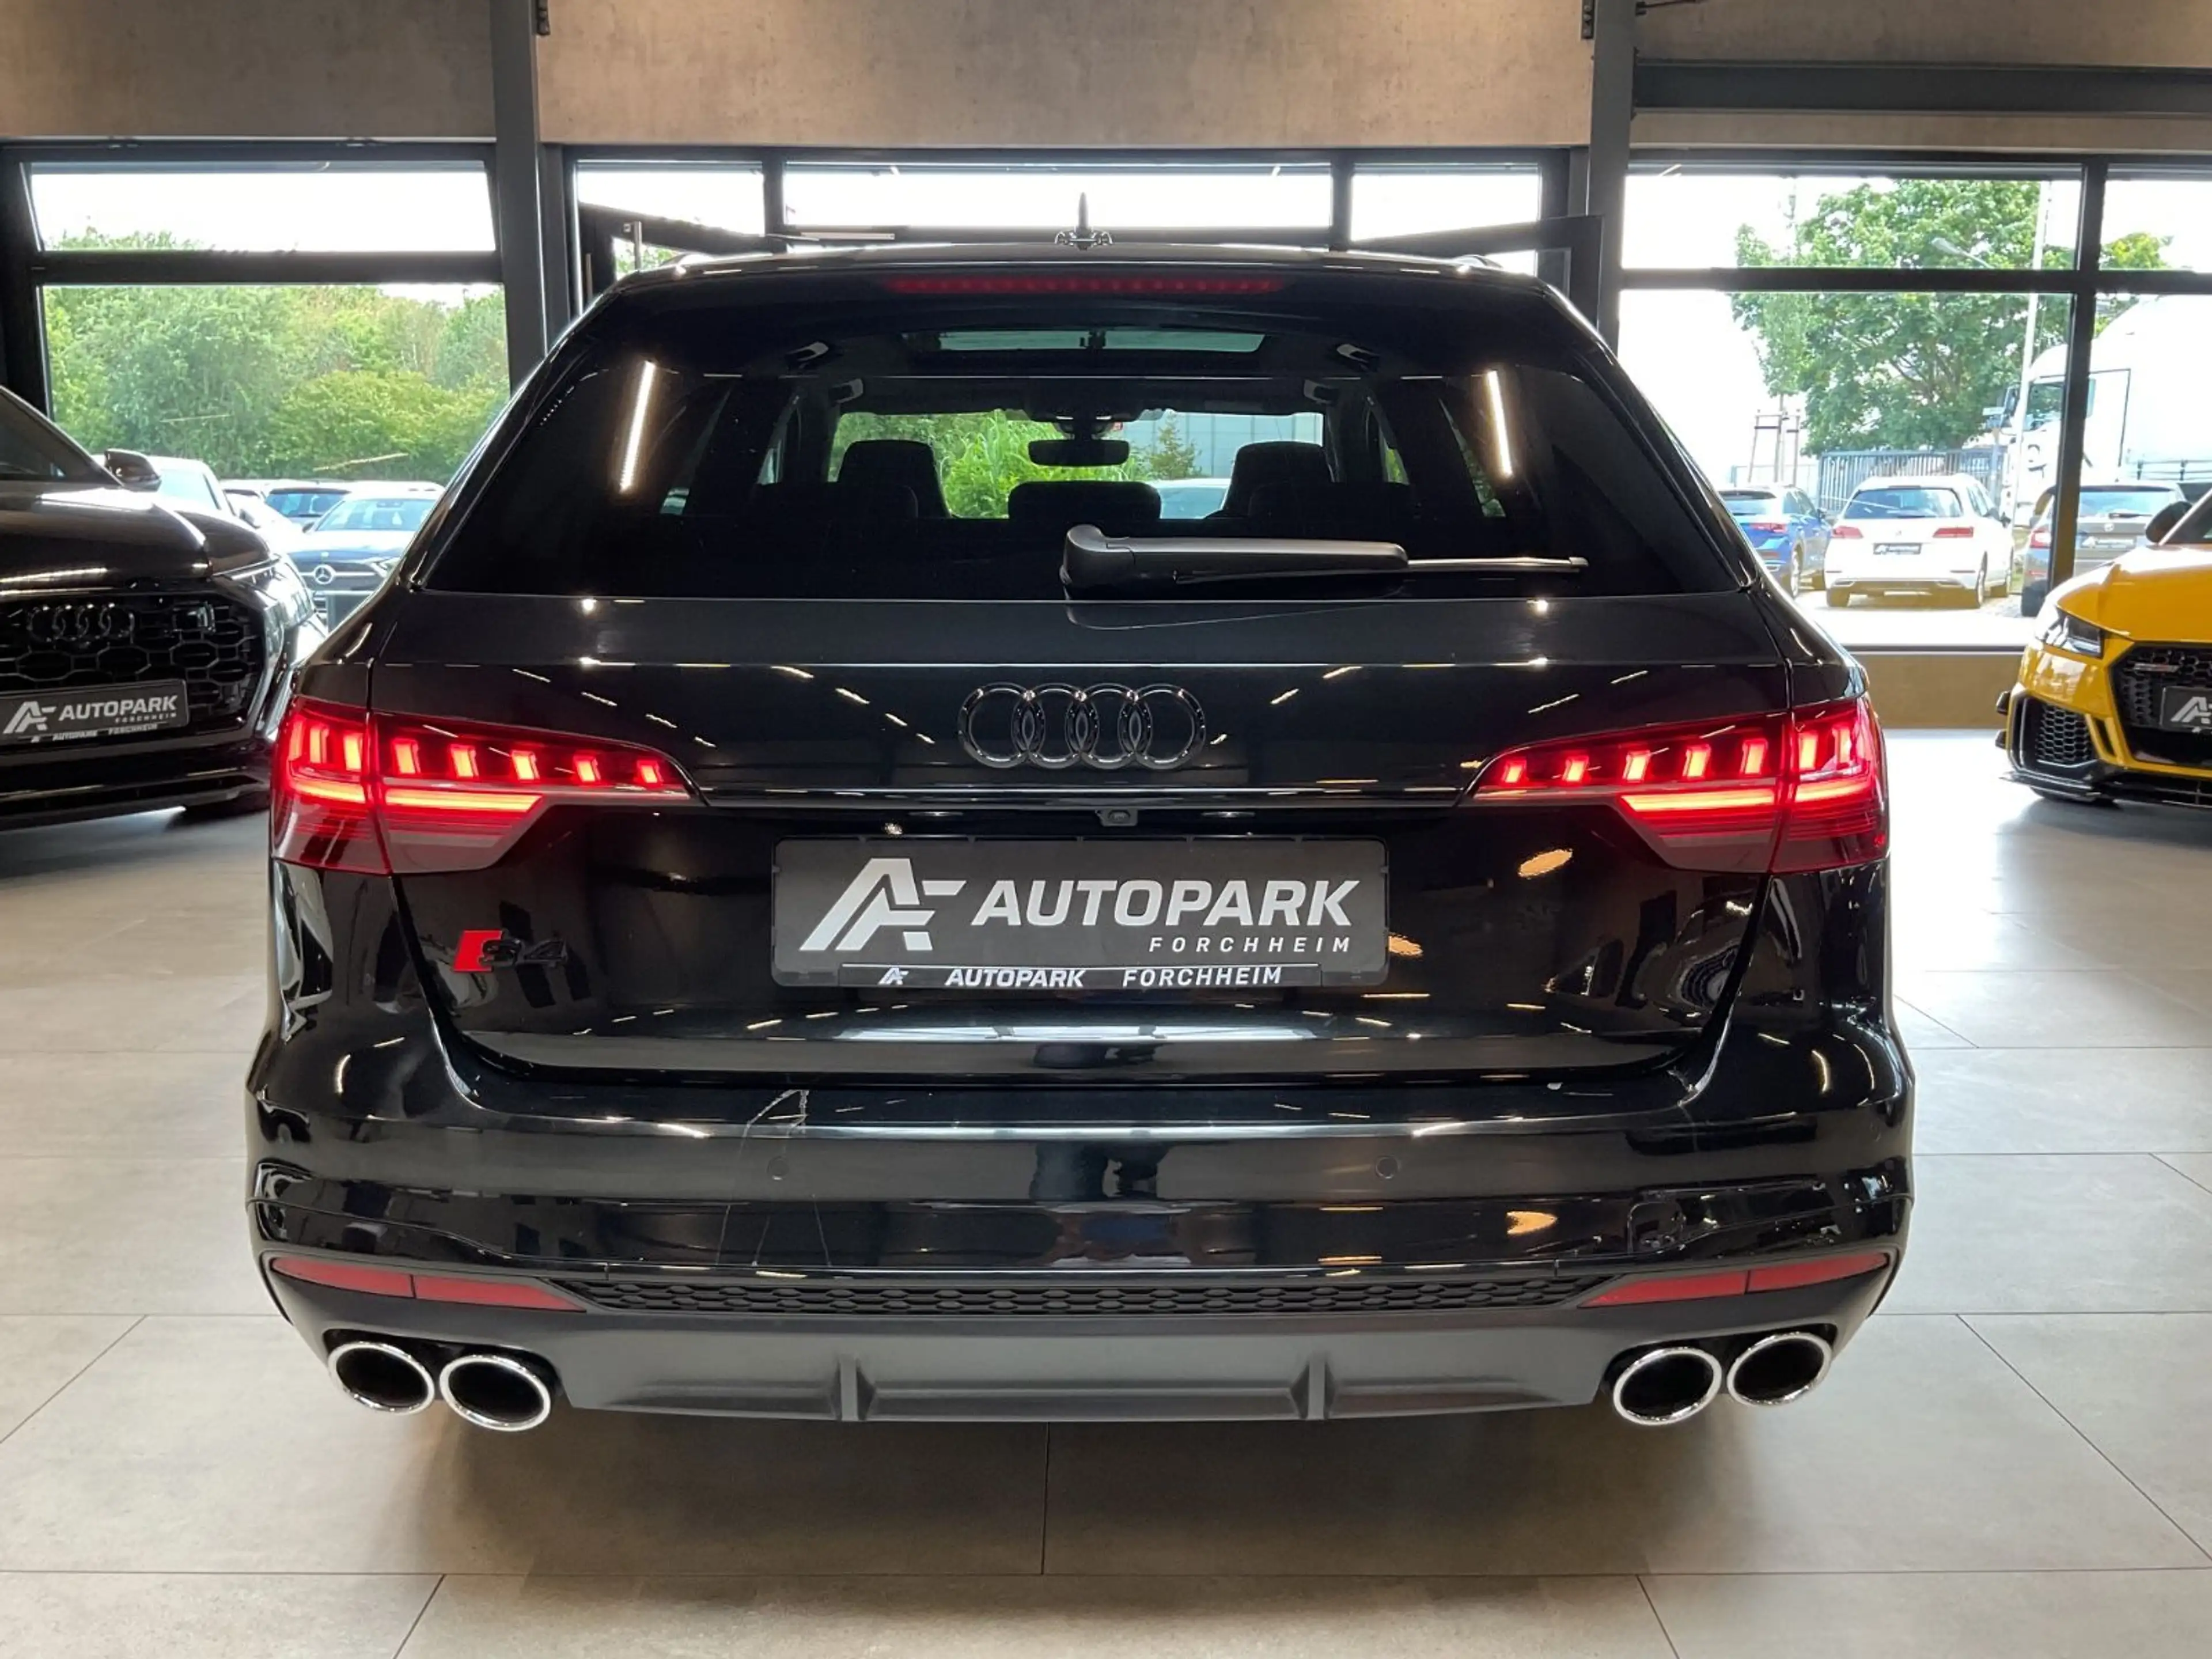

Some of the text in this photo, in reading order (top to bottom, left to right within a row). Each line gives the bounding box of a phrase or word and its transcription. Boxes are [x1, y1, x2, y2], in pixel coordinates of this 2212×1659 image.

[58, 695, 177, 721] AUTOPARK
[971, 880, 1360, 926] AUTOPARK
[1148, 937, 1352, 953] FORCHHEIM
[945, 968, 1086, 988] AUTOPARK
[1123, 966, 1282, 987] FORCHHEIM
